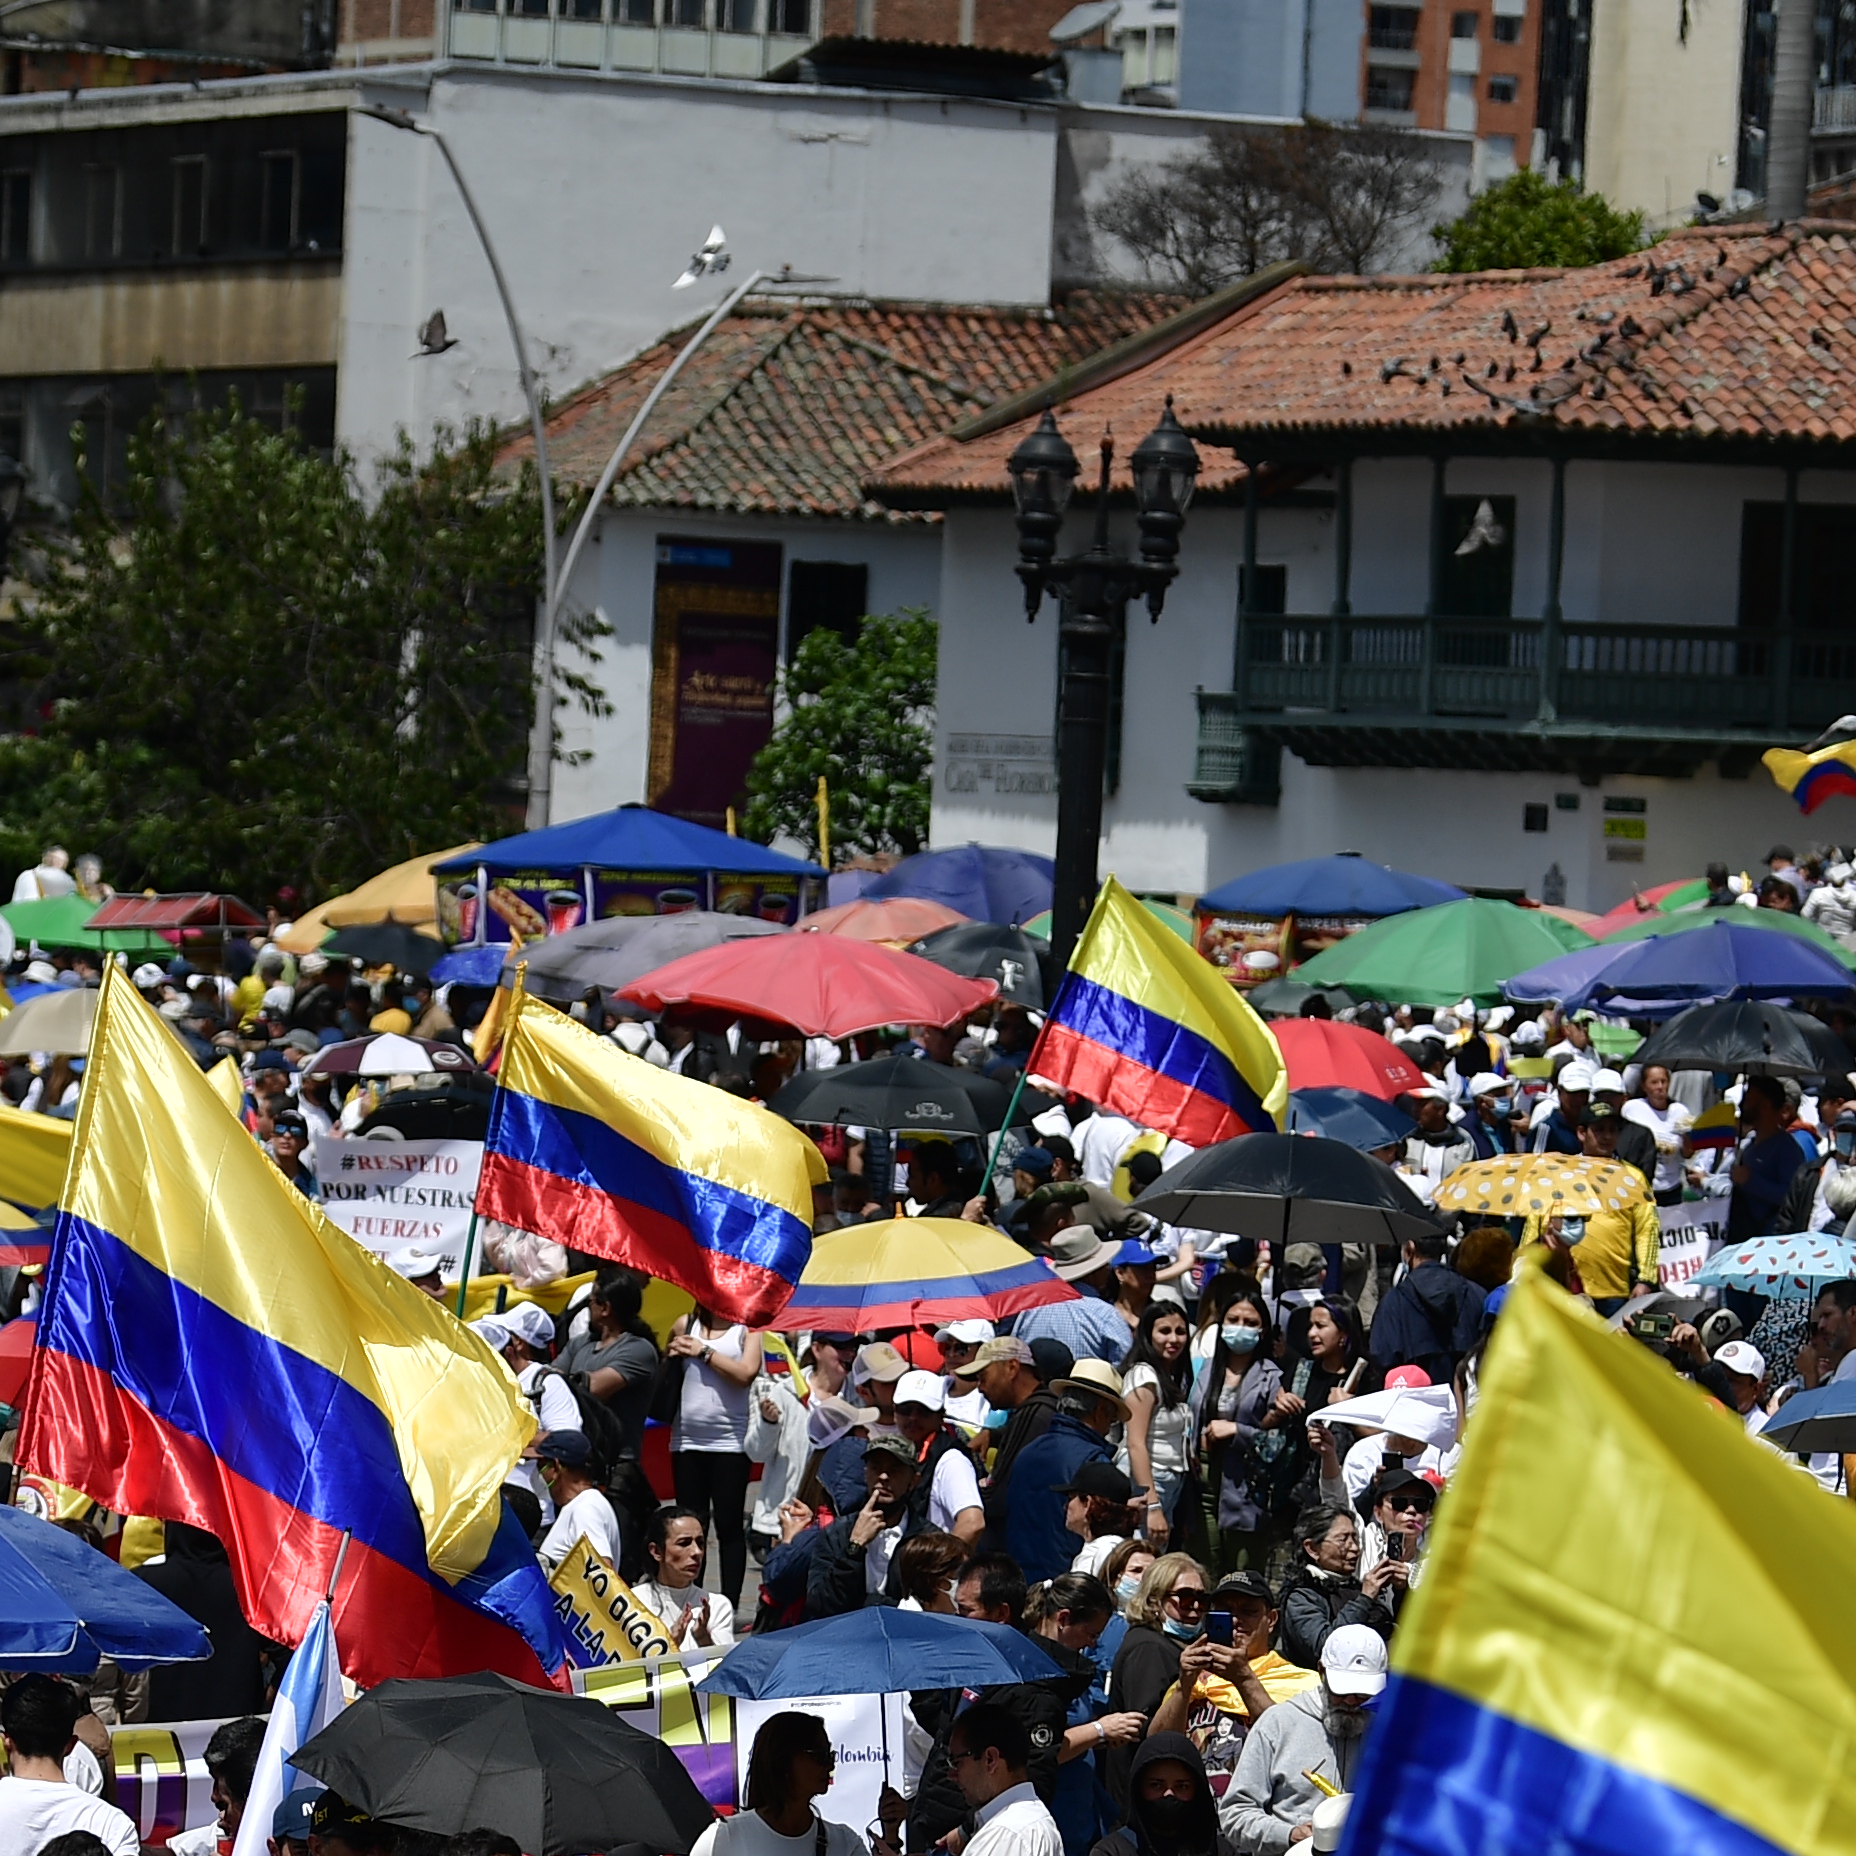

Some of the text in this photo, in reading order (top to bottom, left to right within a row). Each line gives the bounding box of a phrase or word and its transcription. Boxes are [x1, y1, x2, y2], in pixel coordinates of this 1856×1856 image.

[340, 1154, 459, 1176] #RESPETO
[322, 1182, 476, 1209] POR NUESTRAS
[352, 1215, 444, 1239] FUERZAS
[582, 1556, 609, 1599] YO
[608, 1596, 673, 1664] DIGO
[555, 1598, 607, 1668] A LA
[834, 1743, 896, 1764] olombia
